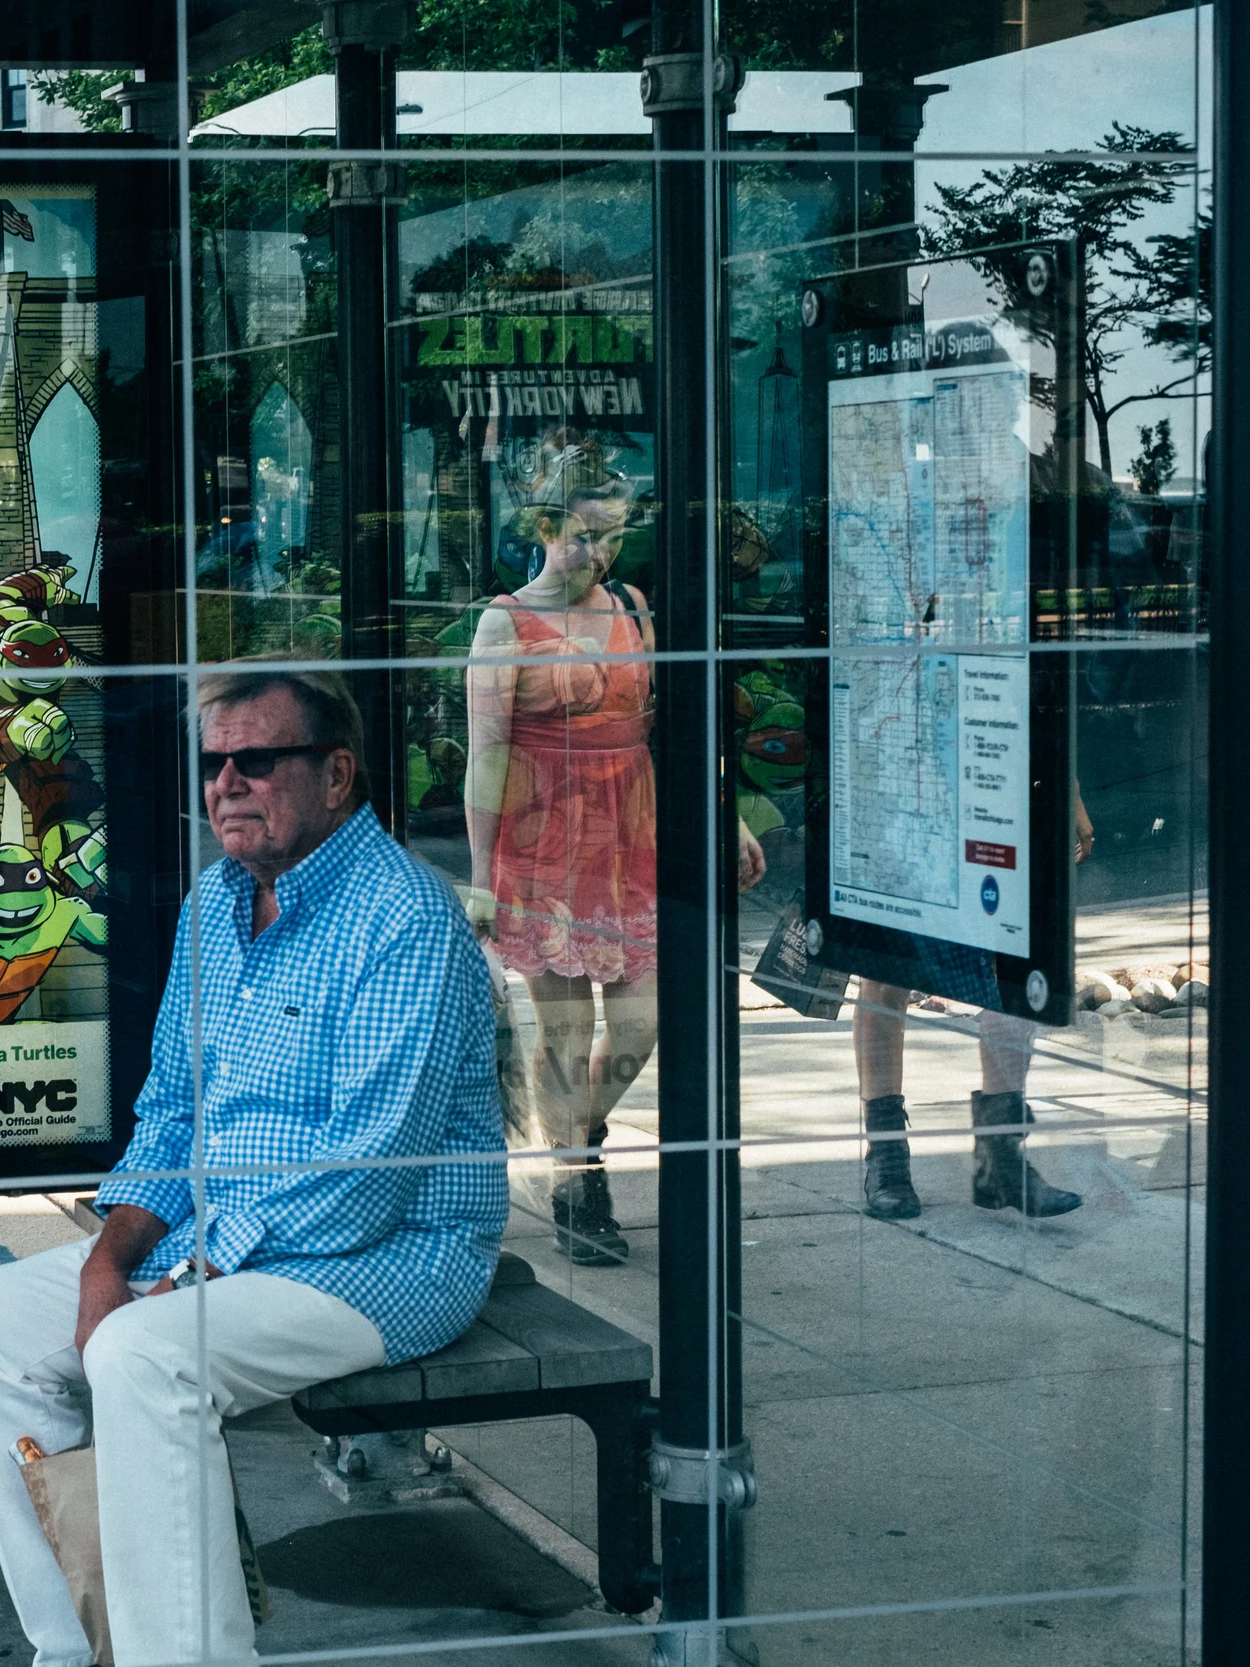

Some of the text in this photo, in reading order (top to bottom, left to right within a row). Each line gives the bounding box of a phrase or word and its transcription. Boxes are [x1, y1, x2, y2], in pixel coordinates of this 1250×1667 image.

[868, 344, 889, 364] Bus
[891, 341, 899, 360] &
[901, 338, 923, 359] Rail
[948, 333, 992, 360] System
[783, 931, 808, 954] FRES
[11, 1043, 78, 1062] Turtles
[5, 1115, 43, 1127] Official
[46, 1114, 77, 1125] Guide
